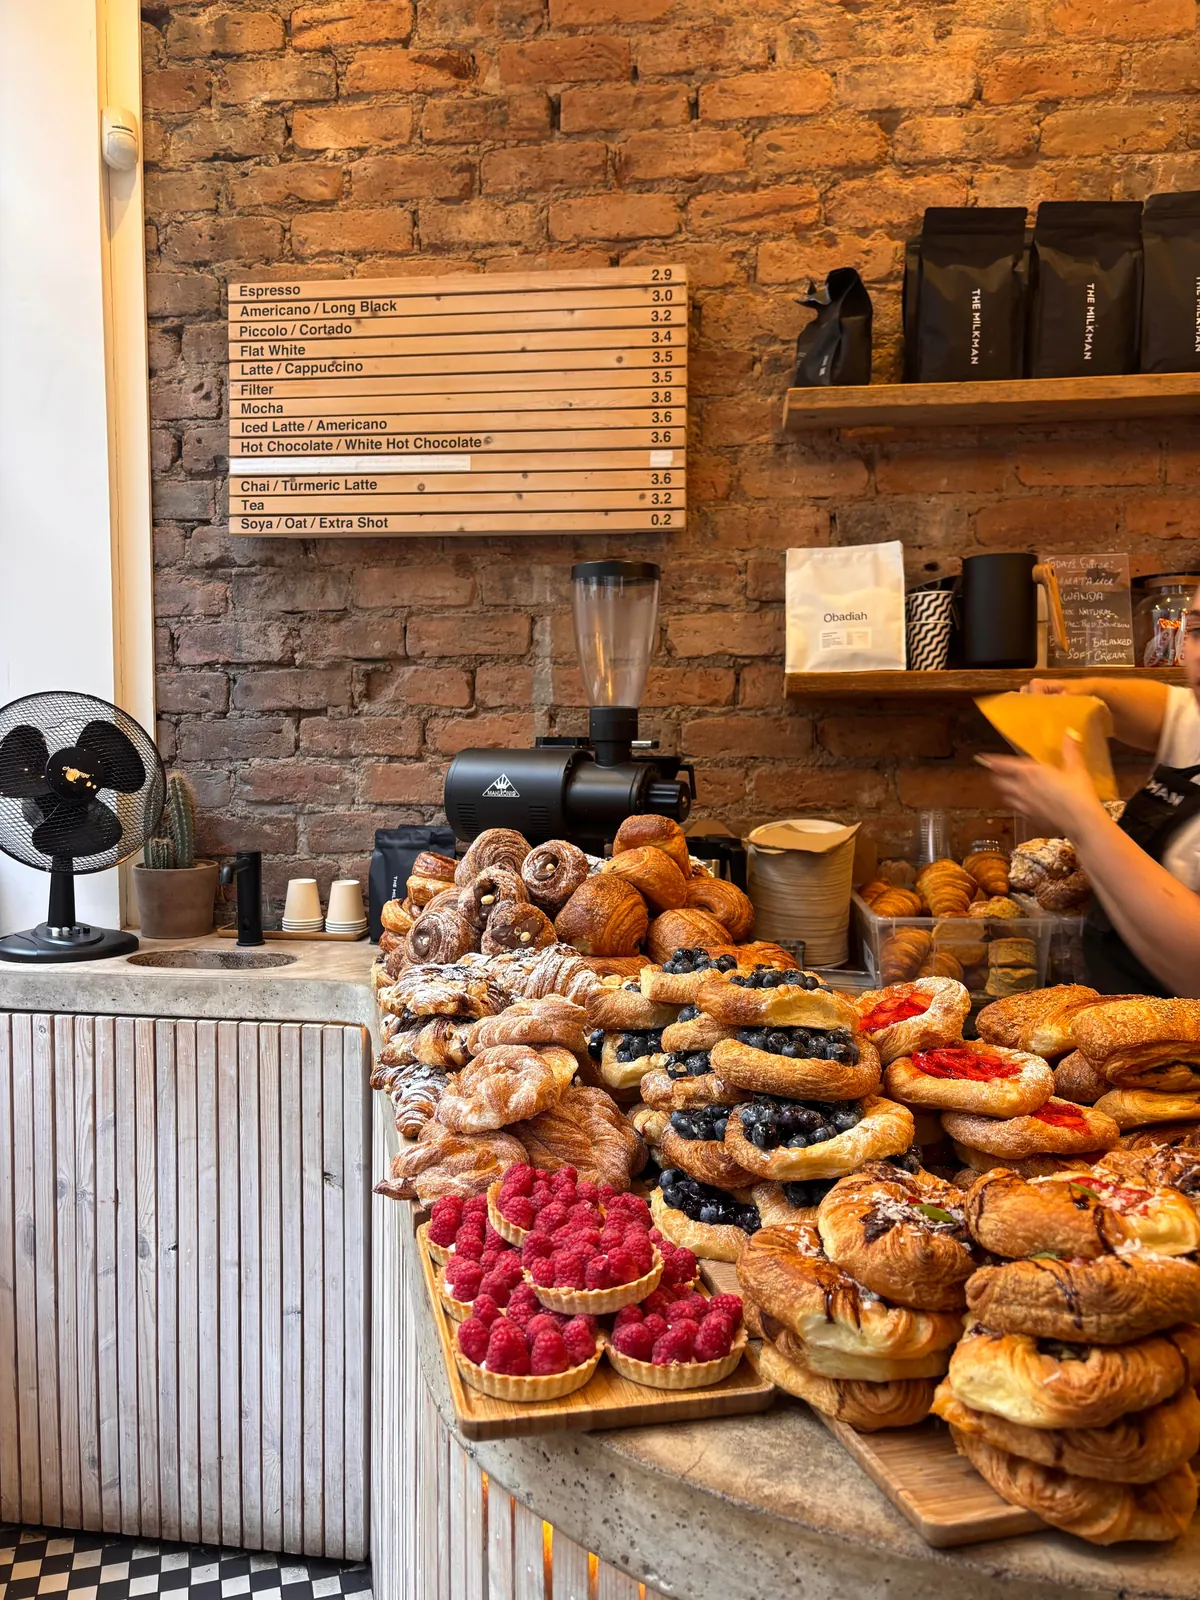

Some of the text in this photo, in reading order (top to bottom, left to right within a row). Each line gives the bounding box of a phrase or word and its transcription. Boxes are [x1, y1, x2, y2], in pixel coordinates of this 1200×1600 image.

[651, 268, 672, 281] 2.9
[239, 285, 301, 299] Espresso
[651, 289, 672, 302] 3.0
[240, 304, 311, 317] Americano
[322, 302, 356, 316] Long
[360, 300, 397, 313] Black
[651, 310, 672, 322] 3.2
[1083, 283, 1095, 360] THE MILKMAN
[239, 325, 288, 338] Piccolo
[299, 323, 352, 336] Cortado
[970, 288, 981, 365] THE MILKMAN
[651, 331, 672, 343] 3.4
[240, 344, 306, 357] Flat White
[651, 351, 672, 363] 3.5
[241, 364, 274, 376] Latte
[284, 361, 363, 377] Cappuccino
[651, 371, 672, 383] 3.5
[240, 383, 274, 396] Filter
[651, 391, 672, 403] 3.8
[241, 402, 284, 415] Mocha
[651, 411, 672, 423] 3.6
[241, 421, 268, 433] Iced
[272, 421, 305, 433] Latte
[316, 418, 387, 431] Americano
[651, 431, 672, 443] 3.6
[241, 441, 264, 453] Hot
[267, 439, 333, 452] Chocolate
[344, 438, 383, 450] White
[386, 437, 410, 449] Hot
[413, 436, 482, 449] Chocolate
[240, 480, 270, 492] Chai
[281, 479, 340, 492] Turmeric
[344, 478, 378, 491] Latte
[651, 473, 672, 485] 3.6
[651, 492, 672, 504] 3.2
[241, 500, 265, 511] Tea
[241, 517, 273, 532] Soya
[284, 517, 307, 529] Oat
[319, 516, 354, 529] Extra
[357, 516, 388, 529] Shot
[651, 514, 672, 526] 0.2
[823, 611, 868, 623] Obadiah
